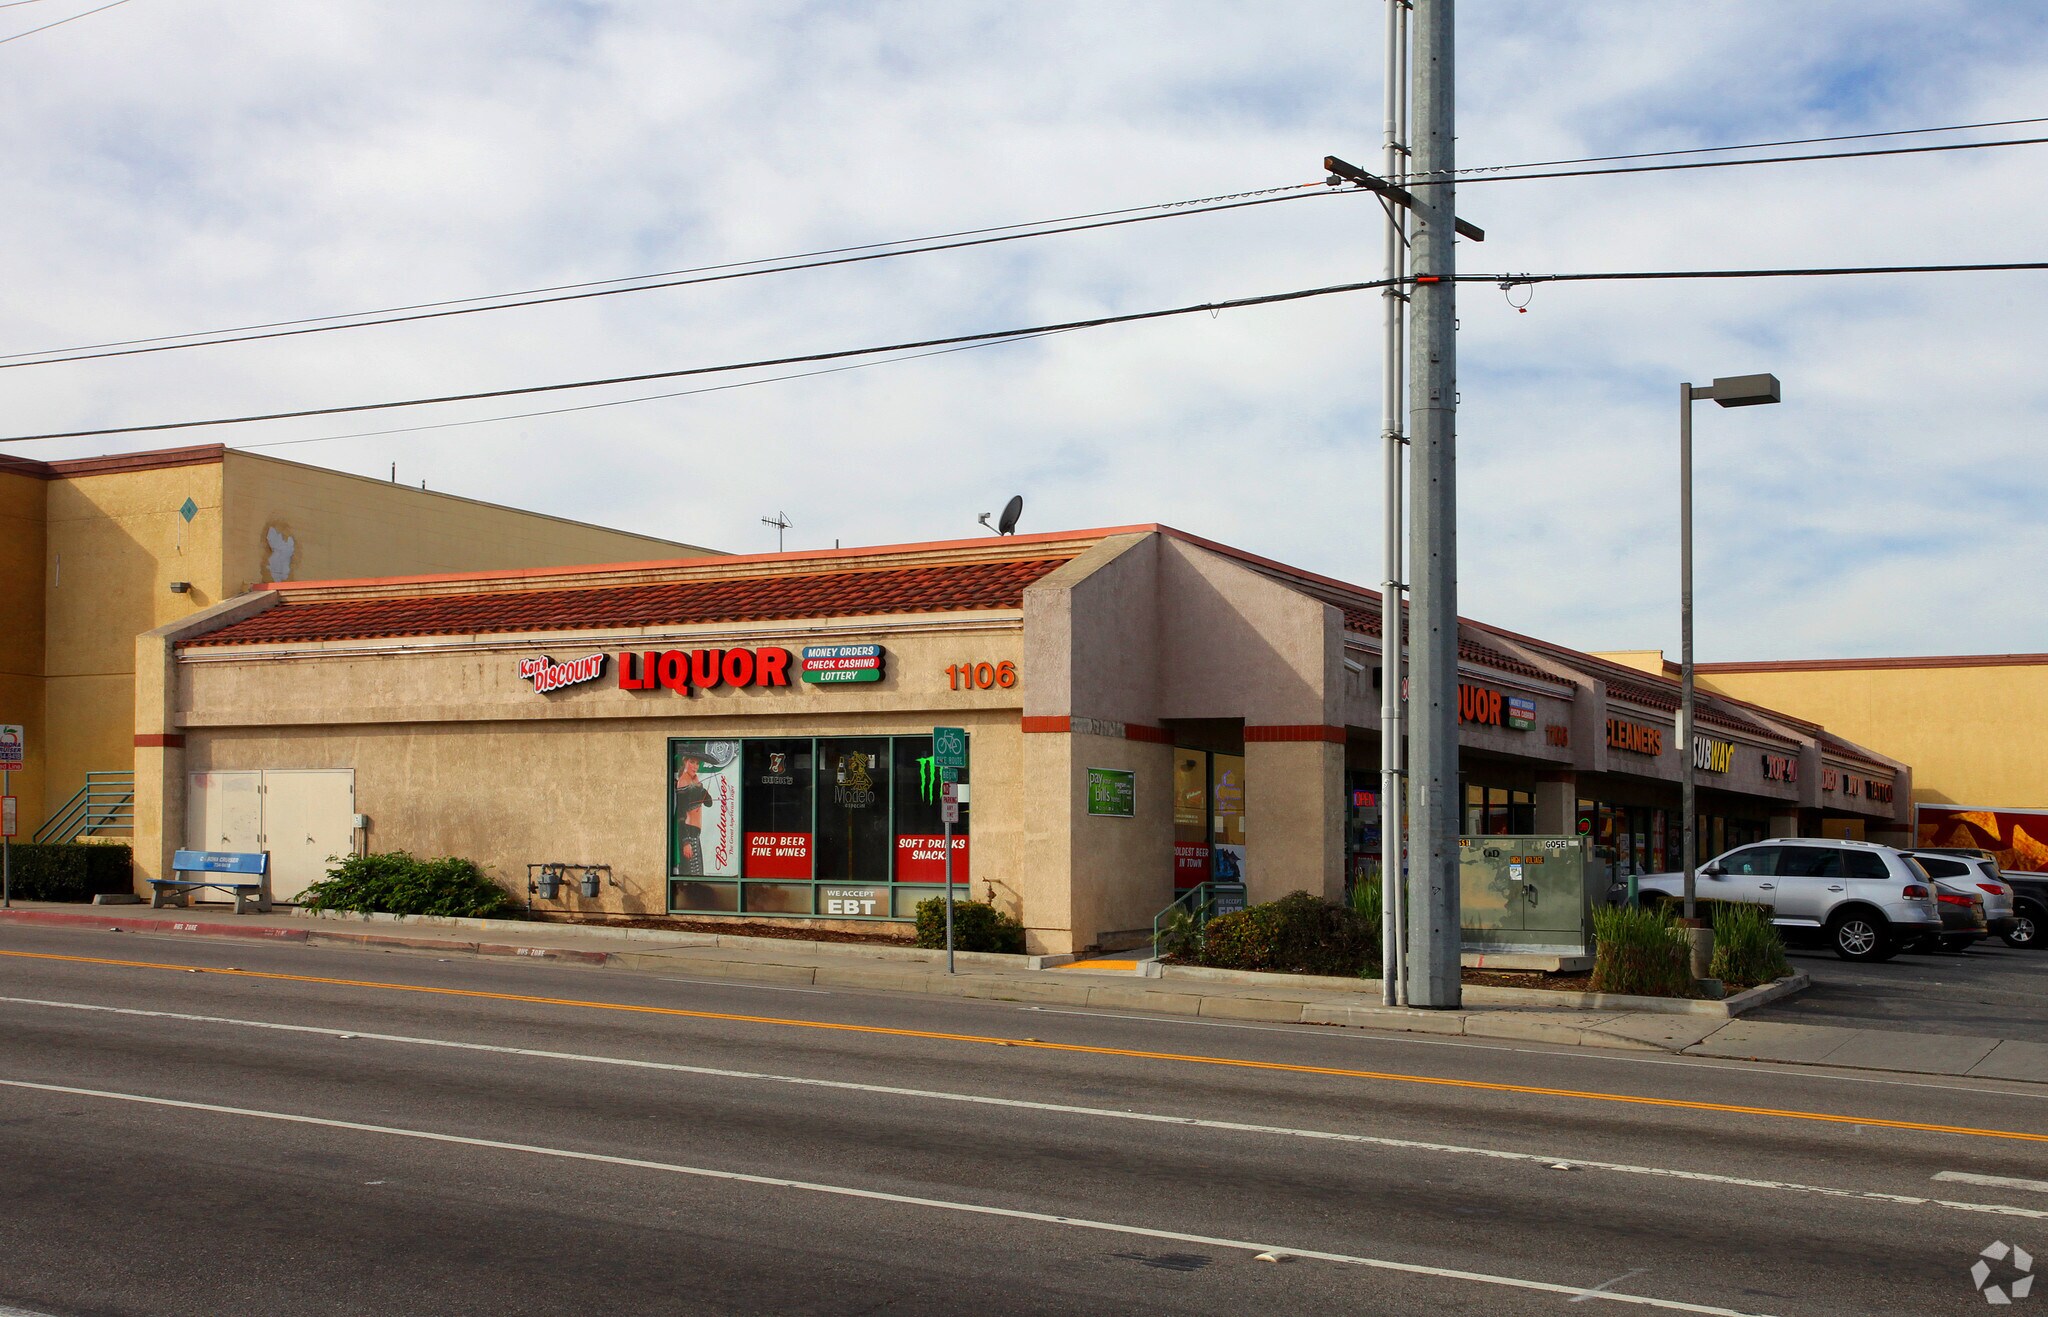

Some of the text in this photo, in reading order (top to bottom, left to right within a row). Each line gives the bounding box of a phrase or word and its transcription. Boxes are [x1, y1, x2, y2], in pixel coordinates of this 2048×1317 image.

[808, 645, 874, 658] MONEY ORDERS
[520, 656, 548, 677] Ken's
[618, 646, 788, 696] LIQUOR
[807, 658, 875, 670] CHECK CASHING
[535, 654, 603, 691] DISCOUNT
[820, 671, 858, 681] LOTTERY
[944, 660, 1016, 690] 1106
[1693, 735, 1735, 773] SUBWAY
[1089, 773, 1104, 788] pay
[834, 785, 875, 804] Modelo
[1095, 786, 1111, 802] bills
[1355, 791, 1375, 807] OPEN
[715, 775, 728, 871] Budweiser
[752, 836, 805, 846] COLD BEER
[898, 838, 966, 849] SOFT DRIKS
[751, 847, 807, 858] FINE WINES
[912, 850, 947, 860] SNACK
[1196, 847, 1209, 857] BEER
[1179, 858, 1202, 868] IN TOWN
[1525, 856, 1544, 864] VOLTAGE
[827, 899, 876, 915] EBT
[516, 947, 529, 955] BUS
